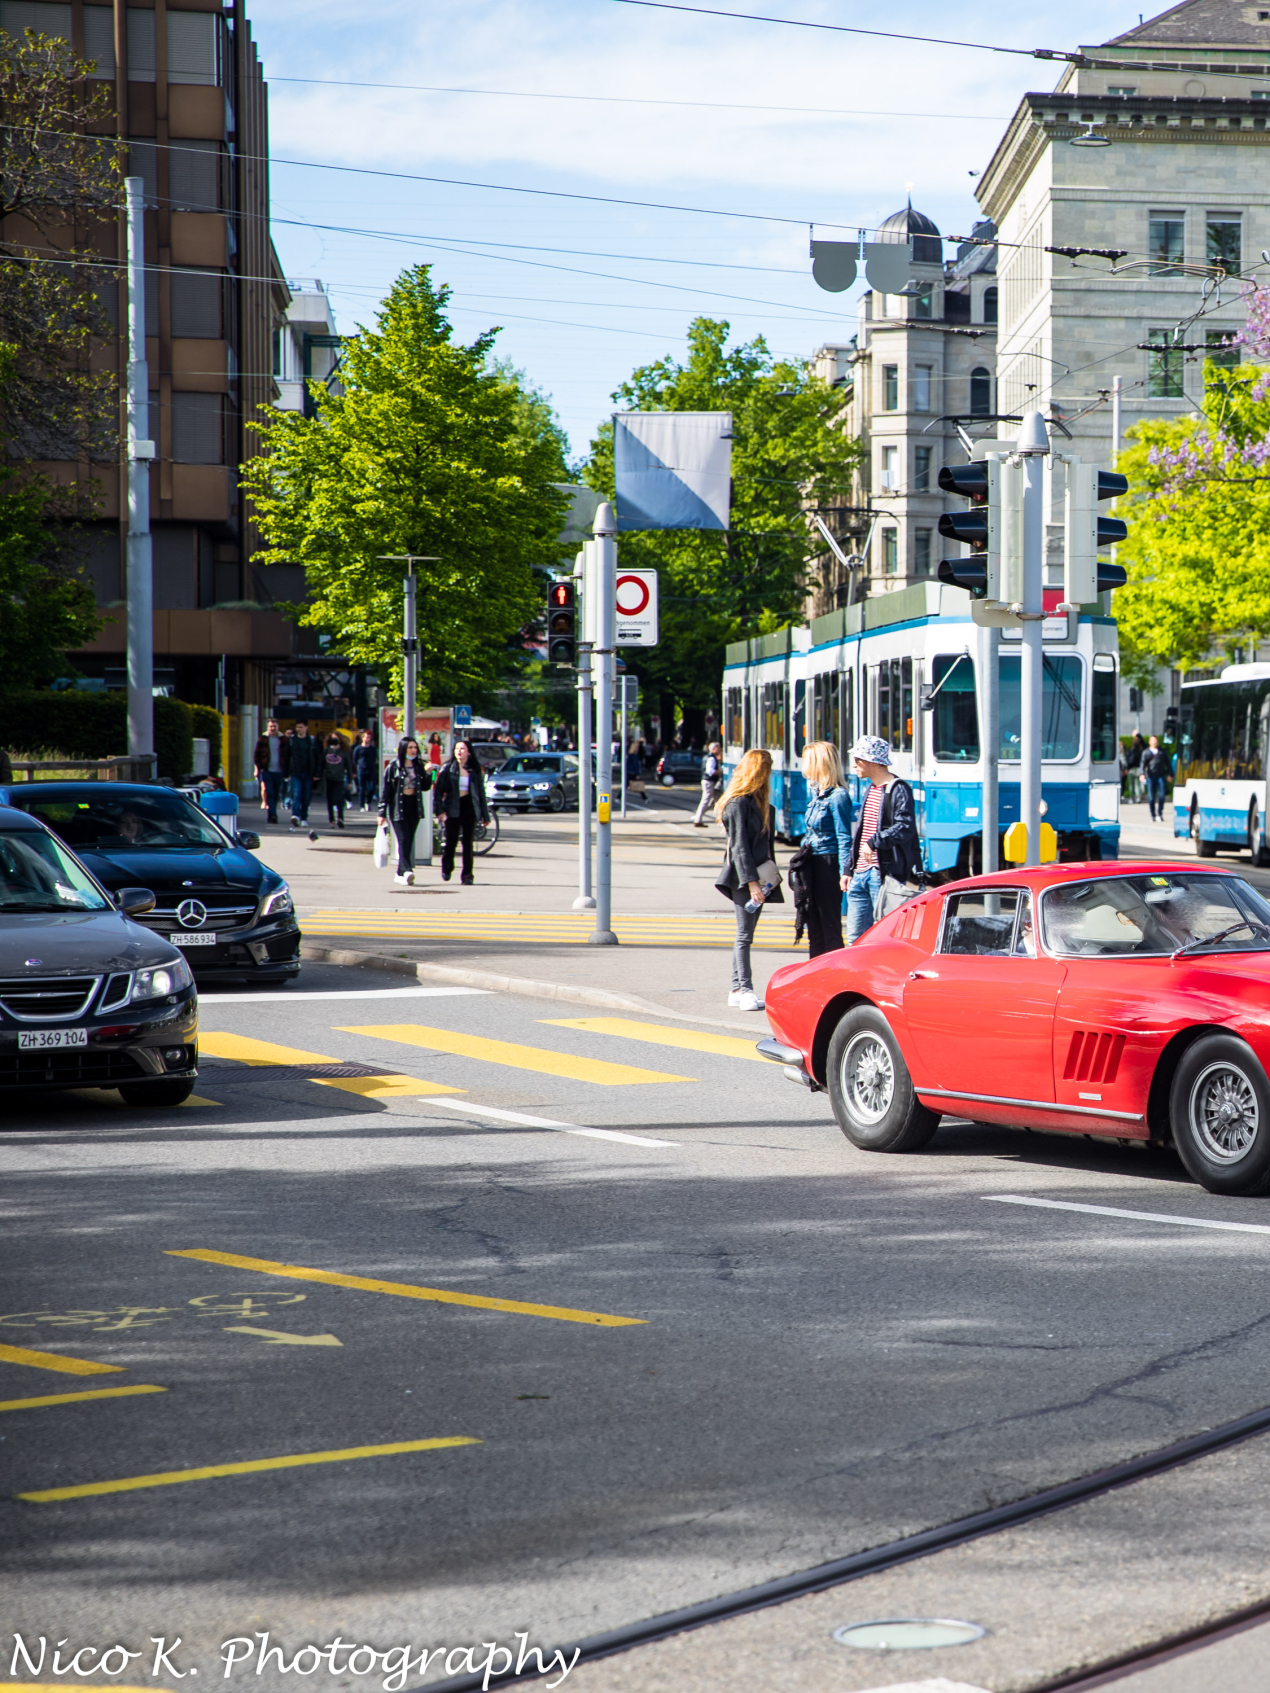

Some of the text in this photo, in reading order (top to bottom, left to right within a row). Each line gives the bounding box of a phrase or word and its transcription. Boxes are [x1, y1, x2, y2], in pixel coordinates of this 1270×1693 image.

[20, 1031, 86, 1047] ZH 369 104
